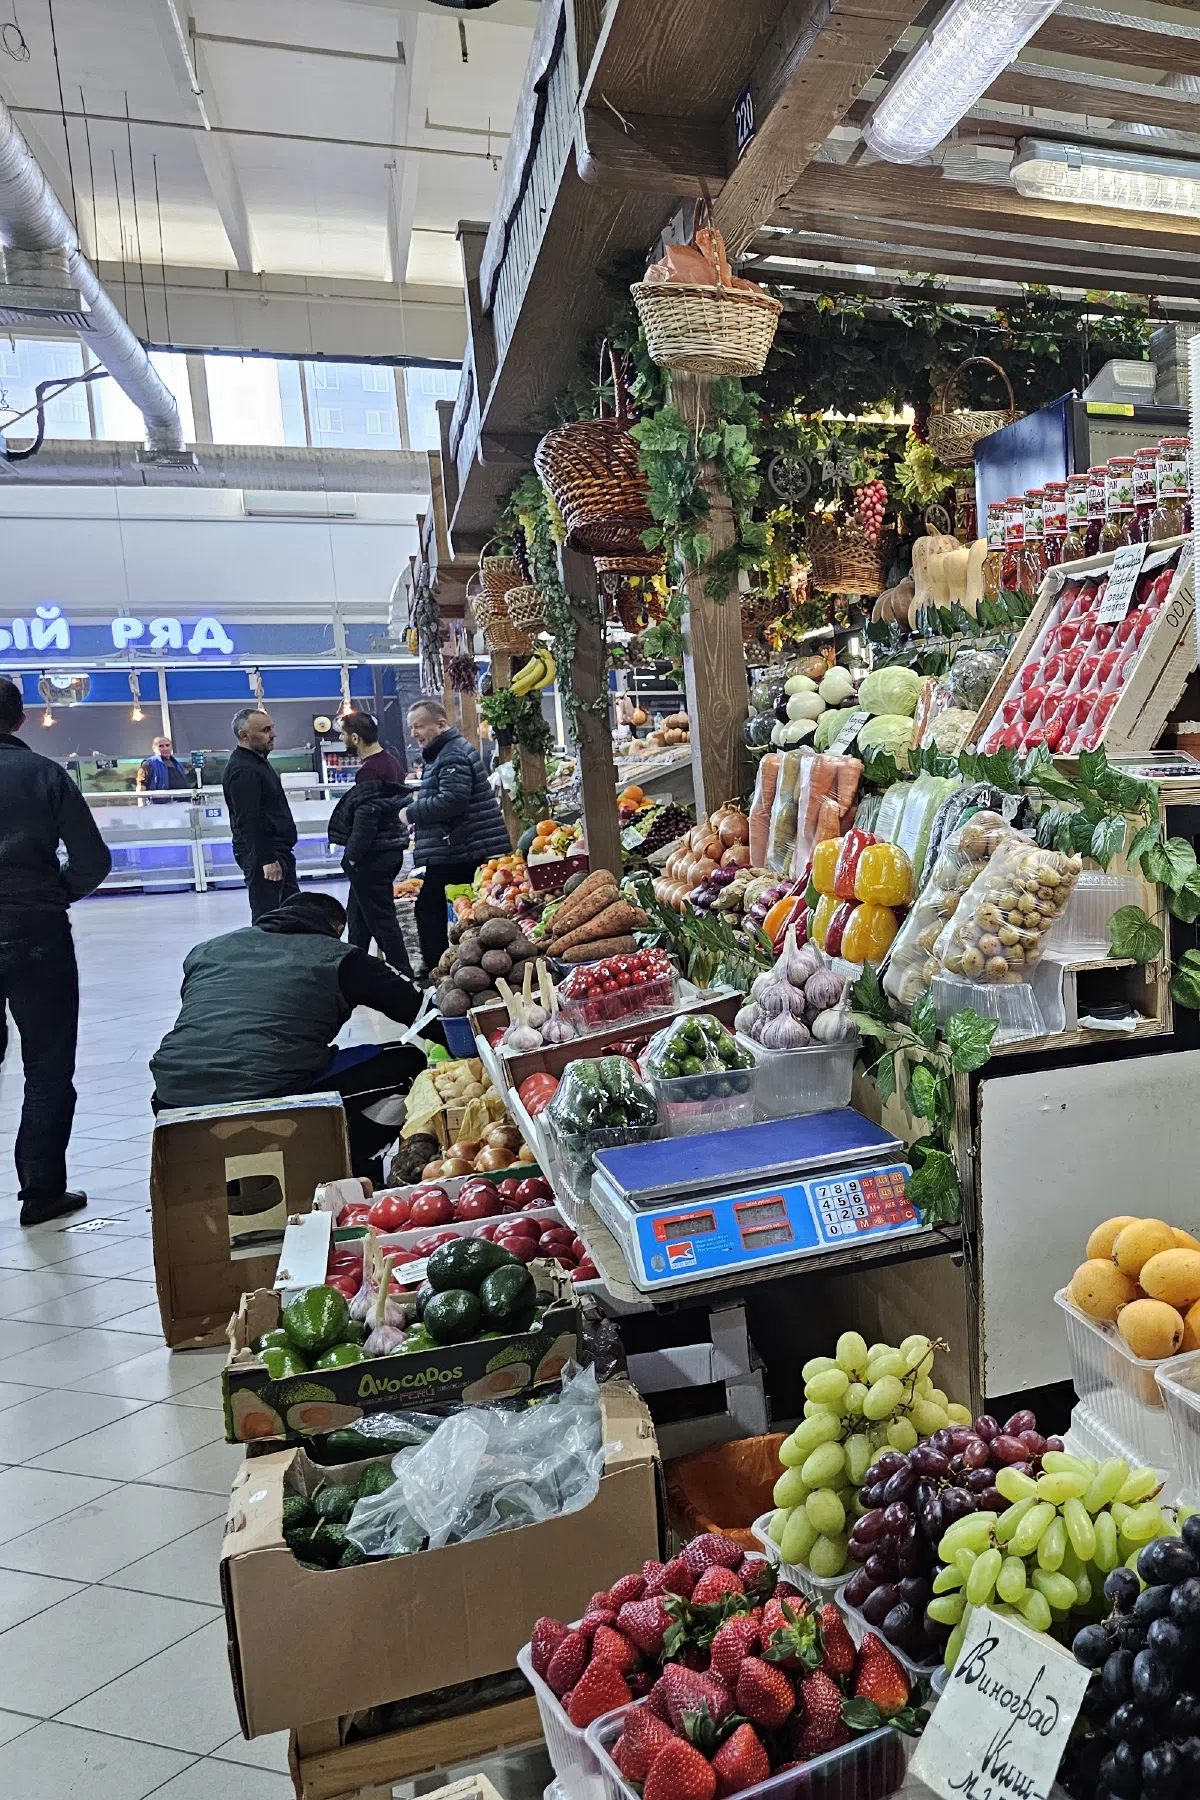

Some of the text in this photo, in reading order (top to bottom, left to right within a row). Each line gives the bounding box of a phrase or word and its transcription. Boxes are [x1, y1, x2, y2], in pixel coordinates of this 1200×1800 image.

[736, 92, 754, 148] 220
[111, 617, 234, 655] РЯД
[818, 1187, 826, 1197] 7
[834, 1184, 842, 1194] 8
[848, 1181, 857, 1191] 9
[822, 1200, 831, 1209] 4
[837, 1197, 846, 1206] 5
[852, 1194, 861, 1203] 6
[826, 1212, 832, 1222] 1
[841, 1209, 850, 1219] 2
[857, 1206, 865, 1216] 3
[830, 1225, 838, 1235] 0
[357, 1366, 463, 1398] AVOCADOS
[955, 1620, 1060, 1742] Виноград
